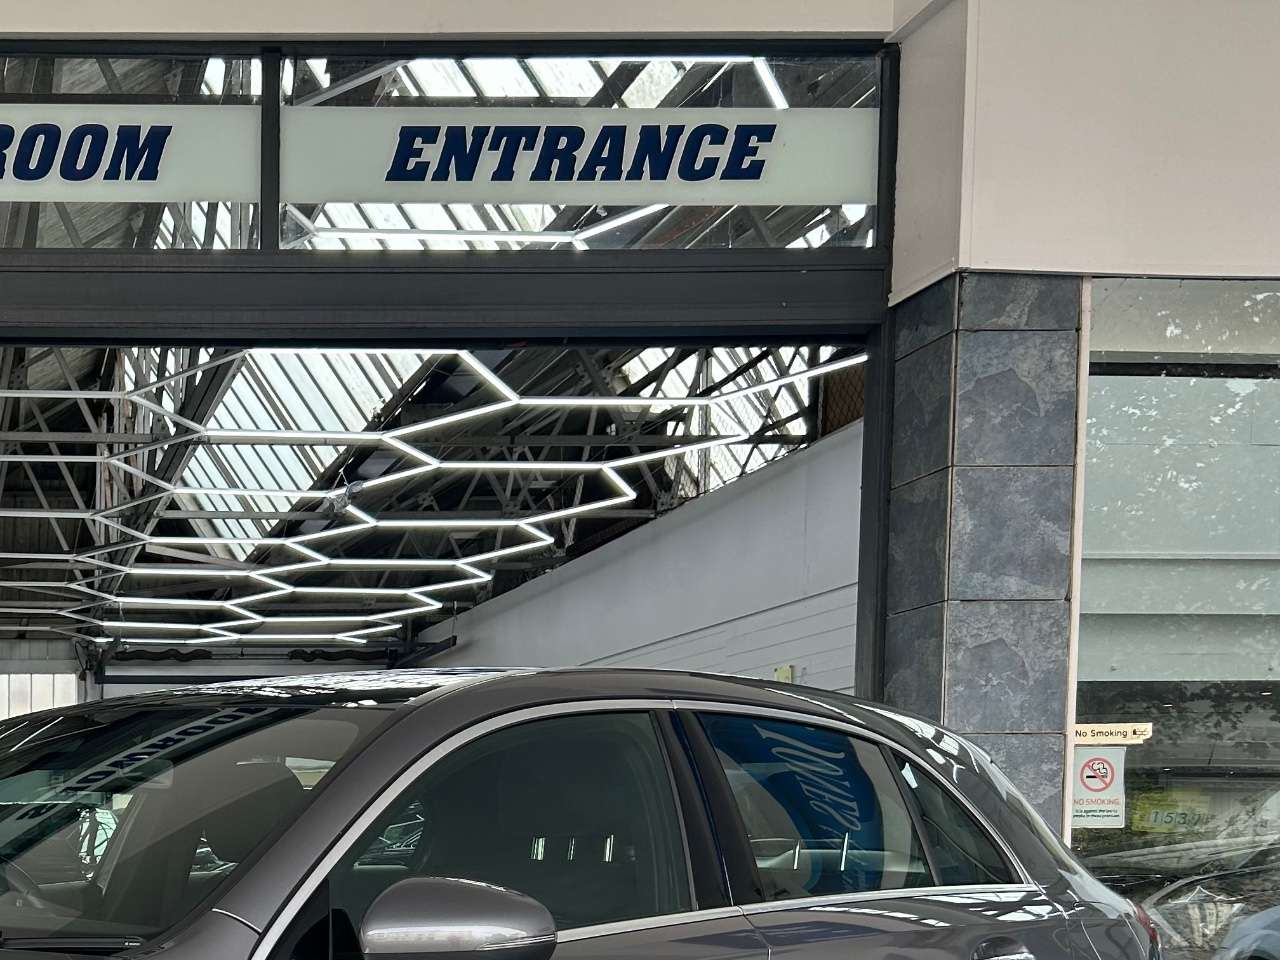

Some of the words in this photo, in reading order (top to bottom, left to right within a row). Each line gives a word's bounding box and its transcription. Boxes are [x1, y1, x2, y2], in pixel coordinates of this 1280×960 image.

[384, 123, 777, 182] ENTRANCE
[1075, 729, 1088, 737] No
[1091, 729, 1128, 739] Smoking
